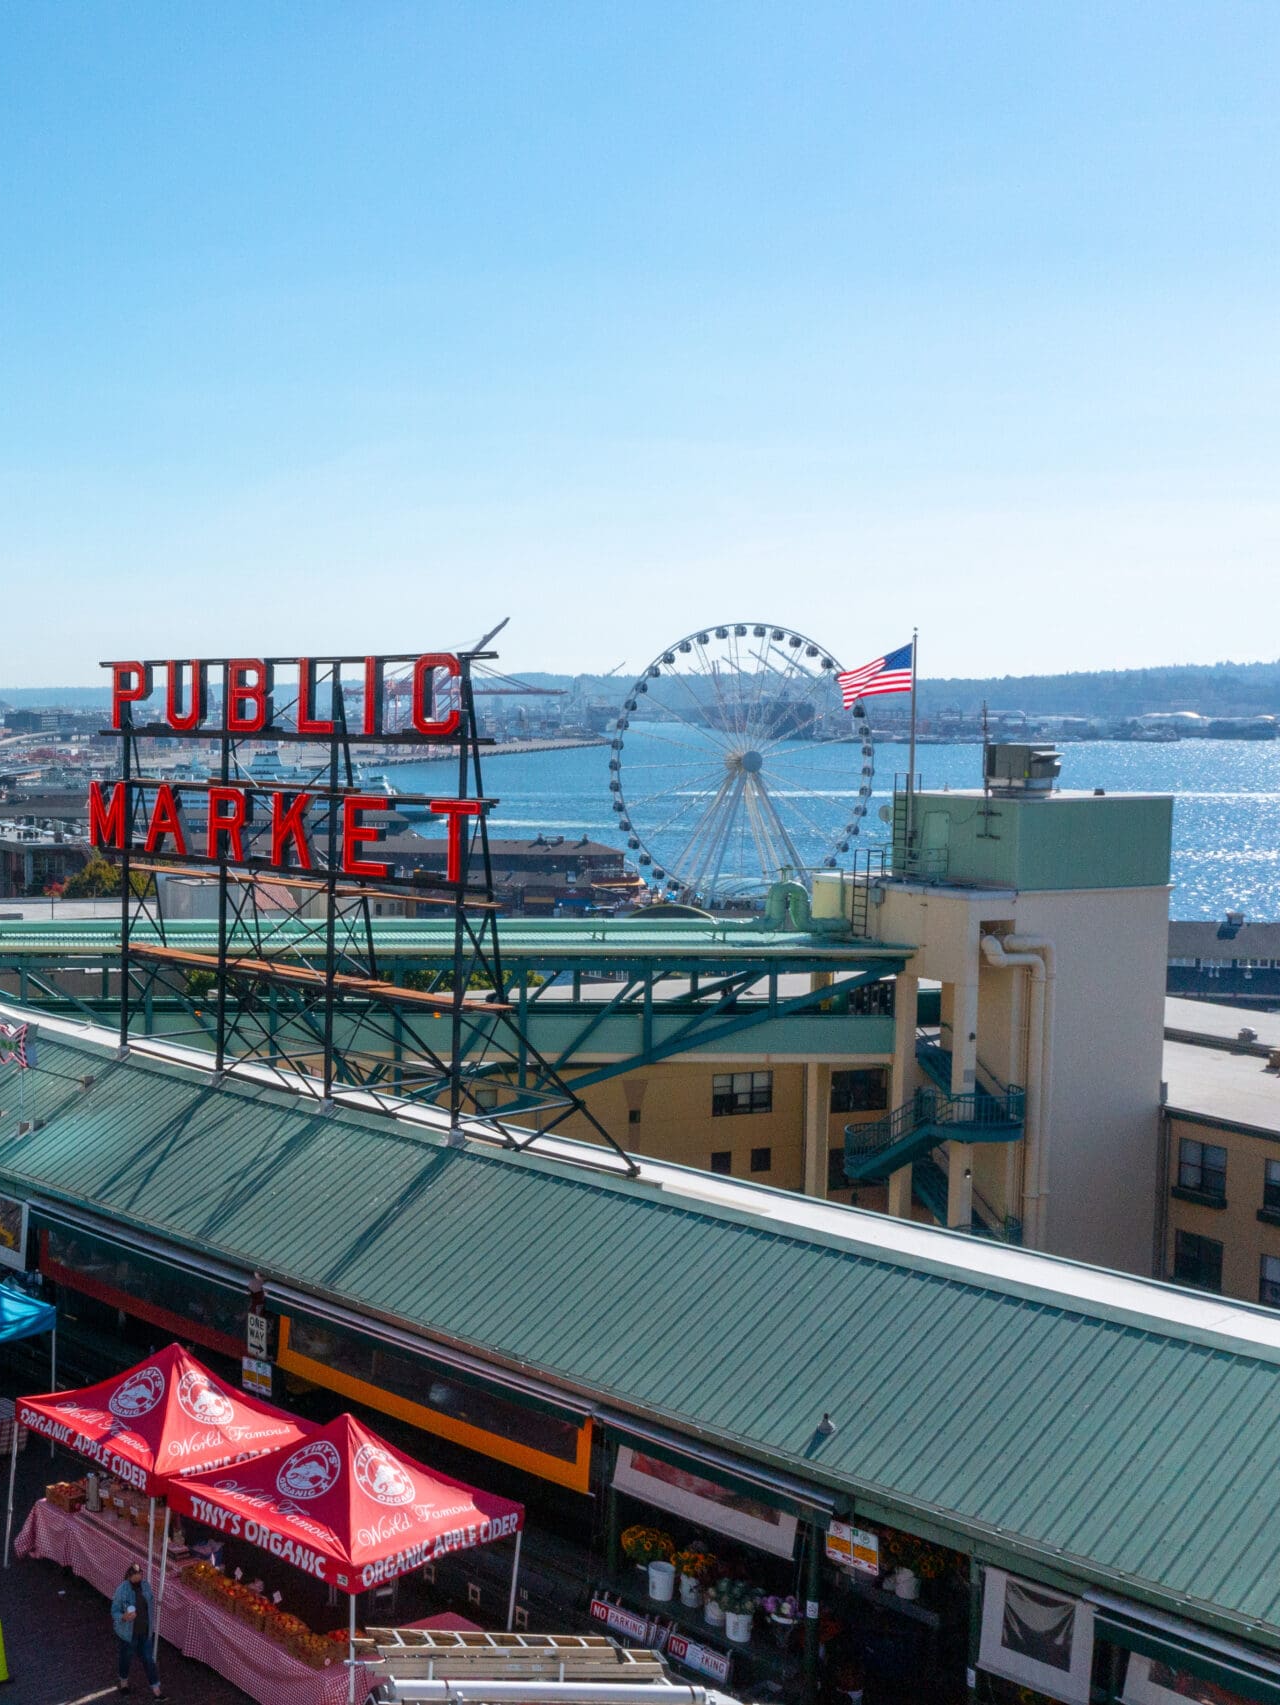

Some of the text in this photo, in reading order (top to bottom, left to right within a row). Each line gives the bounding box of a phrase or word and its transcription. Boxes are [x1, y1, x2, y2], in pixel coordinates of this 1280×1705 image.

[111, 652, 461, 735] PUBLIC
[89, 780, 481, 883] MARKET
[249, 1328, 264, 1342] WAY
[250, 1316, 264, 1330] ONE
[55, 1401, 151, 1453] World Famous
[168, 1425, 290, 1457] World Famous
[20, 1408, 147, 1491] ORGANIC APPLE CIDER
[302, 1443, 338, 1466] TINY'S
[278, 1477, 316, 1497] ORGANIC
[213, 1479, 338, 1543] World Famous
[357, 1503, 477, 1546] World Famous
[190, 1496, 326, 1579] TINY'S ORGANIC
[362, 1539, 431, 1587] ORGANIC
[434, 1525, 477, 1556] APPLE
[480, 1513, 518, 1543] CIDER
[593, 1603, 607, 1620] NO
[609, 1611, 645, 1637] PARKING
[671, 1639, 685, 1656] NO
